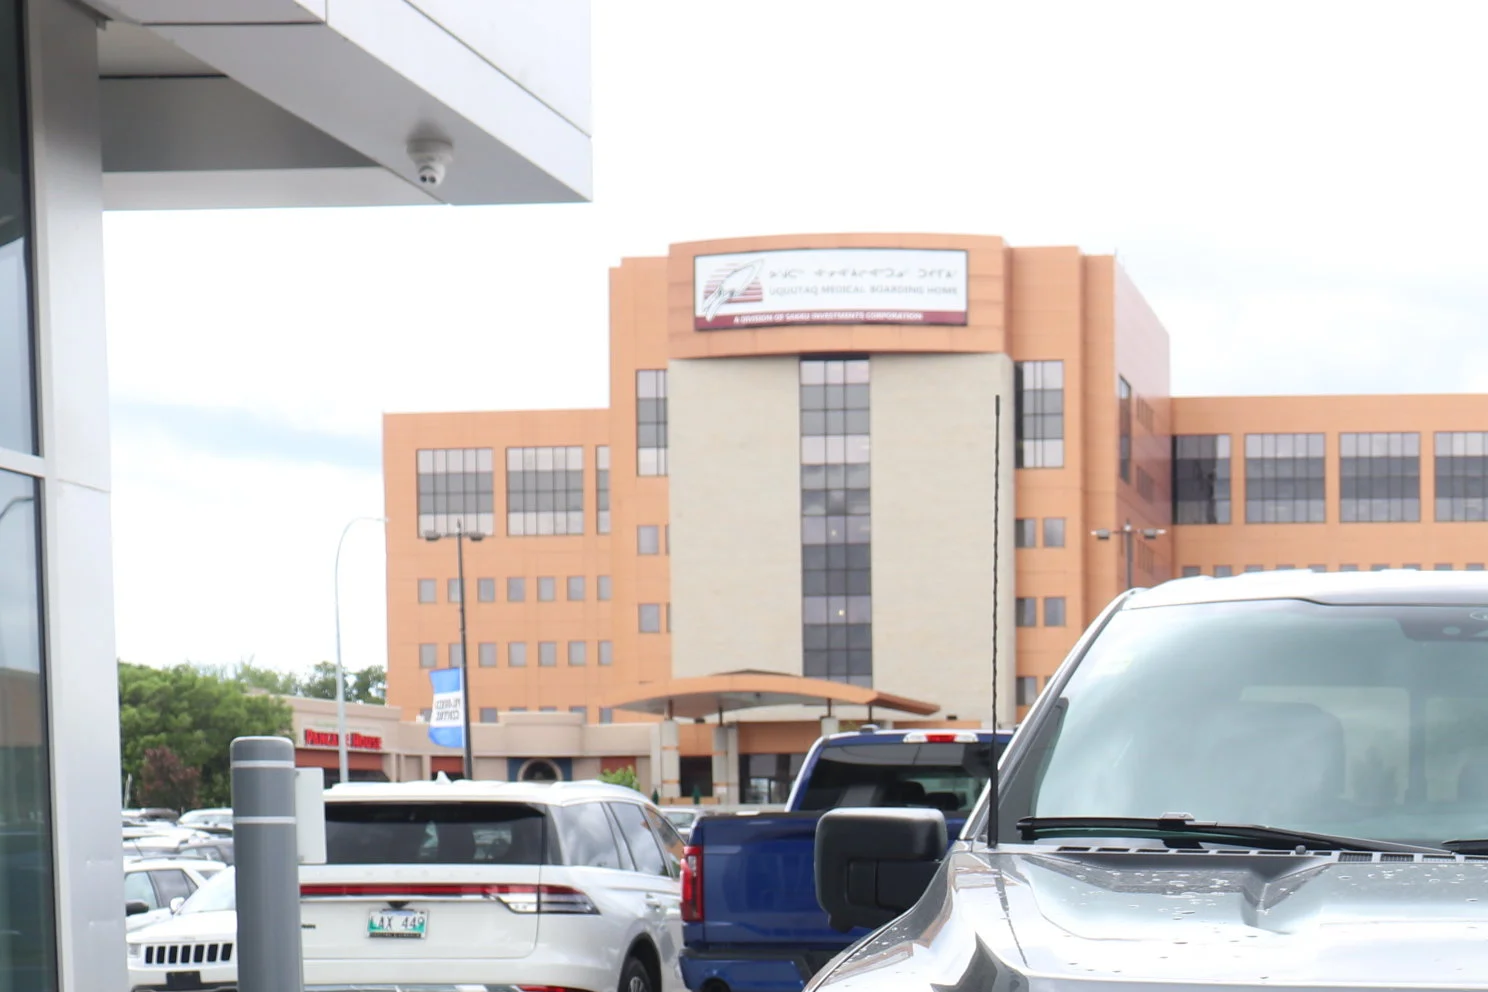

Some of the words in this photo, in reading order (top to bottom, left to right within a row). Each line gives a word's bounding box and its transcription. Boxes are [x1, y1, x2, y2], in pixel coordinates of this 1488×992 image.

[821, 283, 866, 294] MEDICAL
[869, 283, 924, 295] BOARDING
[927, 285, 958, 295] HOME
